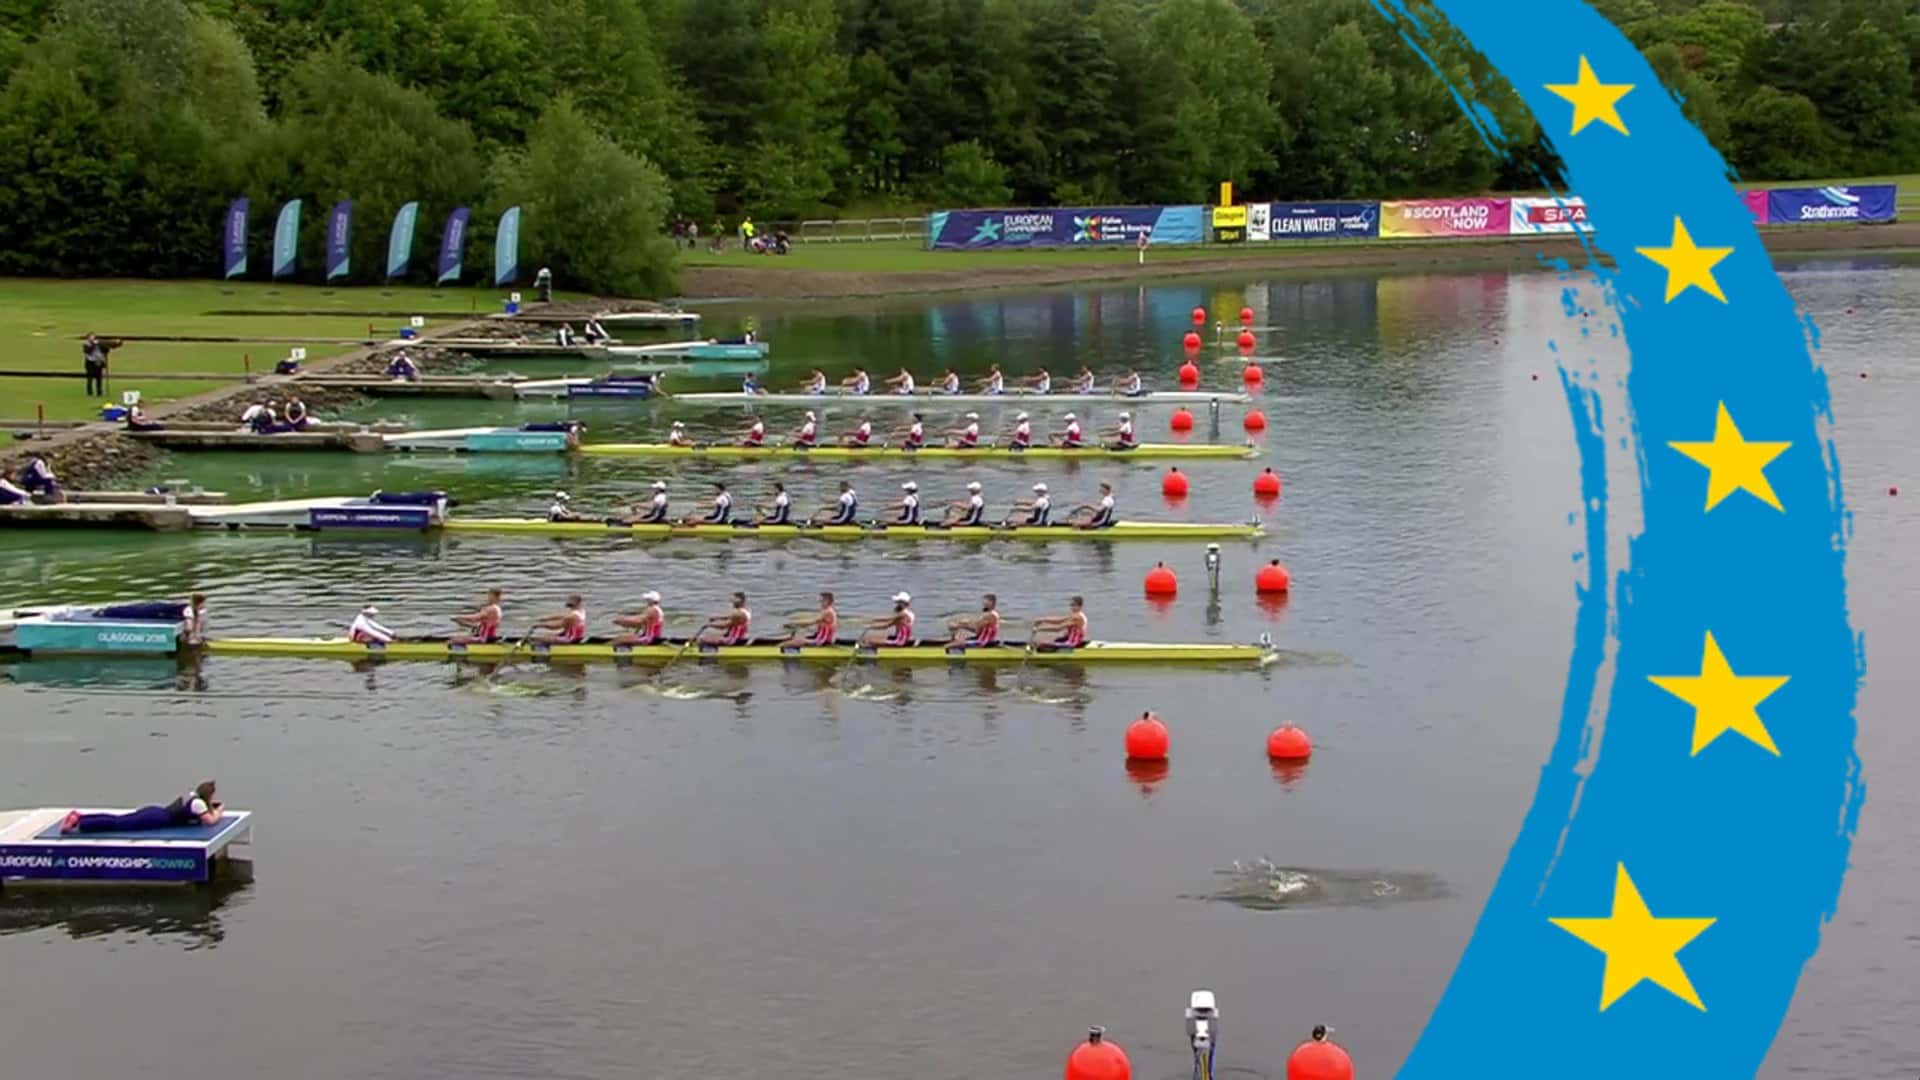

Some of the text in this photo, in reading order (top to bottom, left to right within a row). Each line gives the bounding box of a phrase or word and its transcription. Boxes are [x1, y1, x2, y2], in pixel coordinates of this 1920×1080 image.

[1404, 206, 1489, 218] #SCOTLAND
[1004, 214, 1054, 225] EUROPEAN
[1272, 217, 1336, 233] CLEAN WATER
[1453, 217, 1488, 229] NOW
[97, 631, 144, 643] GLASGOW
[0, 855, 52, 868] UROPEAN
[68, 857, 152, 869] CHAMPIONSHIPS
